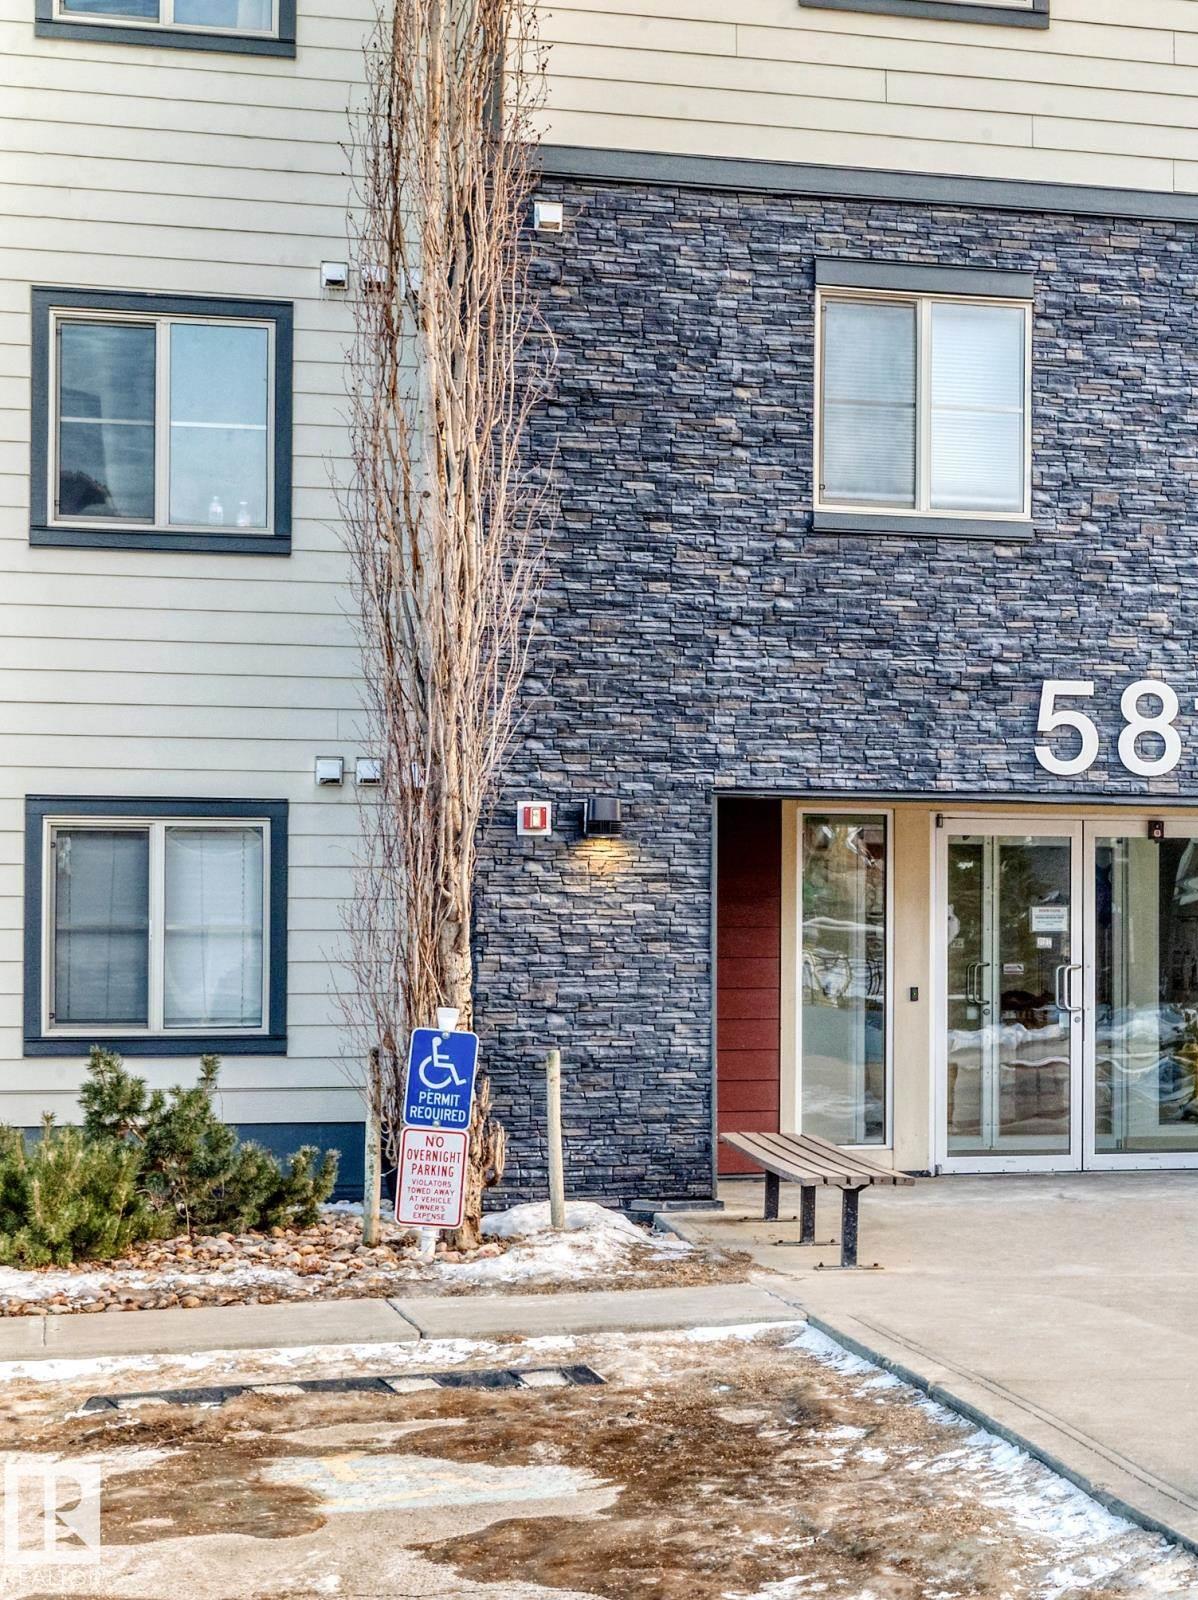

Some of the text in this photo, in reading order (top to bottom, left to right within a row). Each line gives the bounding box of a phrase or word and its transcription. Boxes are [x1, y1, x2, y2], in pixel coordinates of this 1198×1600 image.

[418, 1091, 461, 1107] PERMIT
[409, 1105, 466, 1122] REQUIRED
[426, 1135, 445, 1148] NO
[407, 1149, 461, 1163] OVERNIGHT
[412, 1163, 454, 1177] PARKING
[412, 1179, 452, 1188] VIOLATORS
[407, 1186, 430, 1195] TOWED
[421, 1196, 452, 1205] VEHICLE
[412, 1212, 446, 1220] EXPENSE
